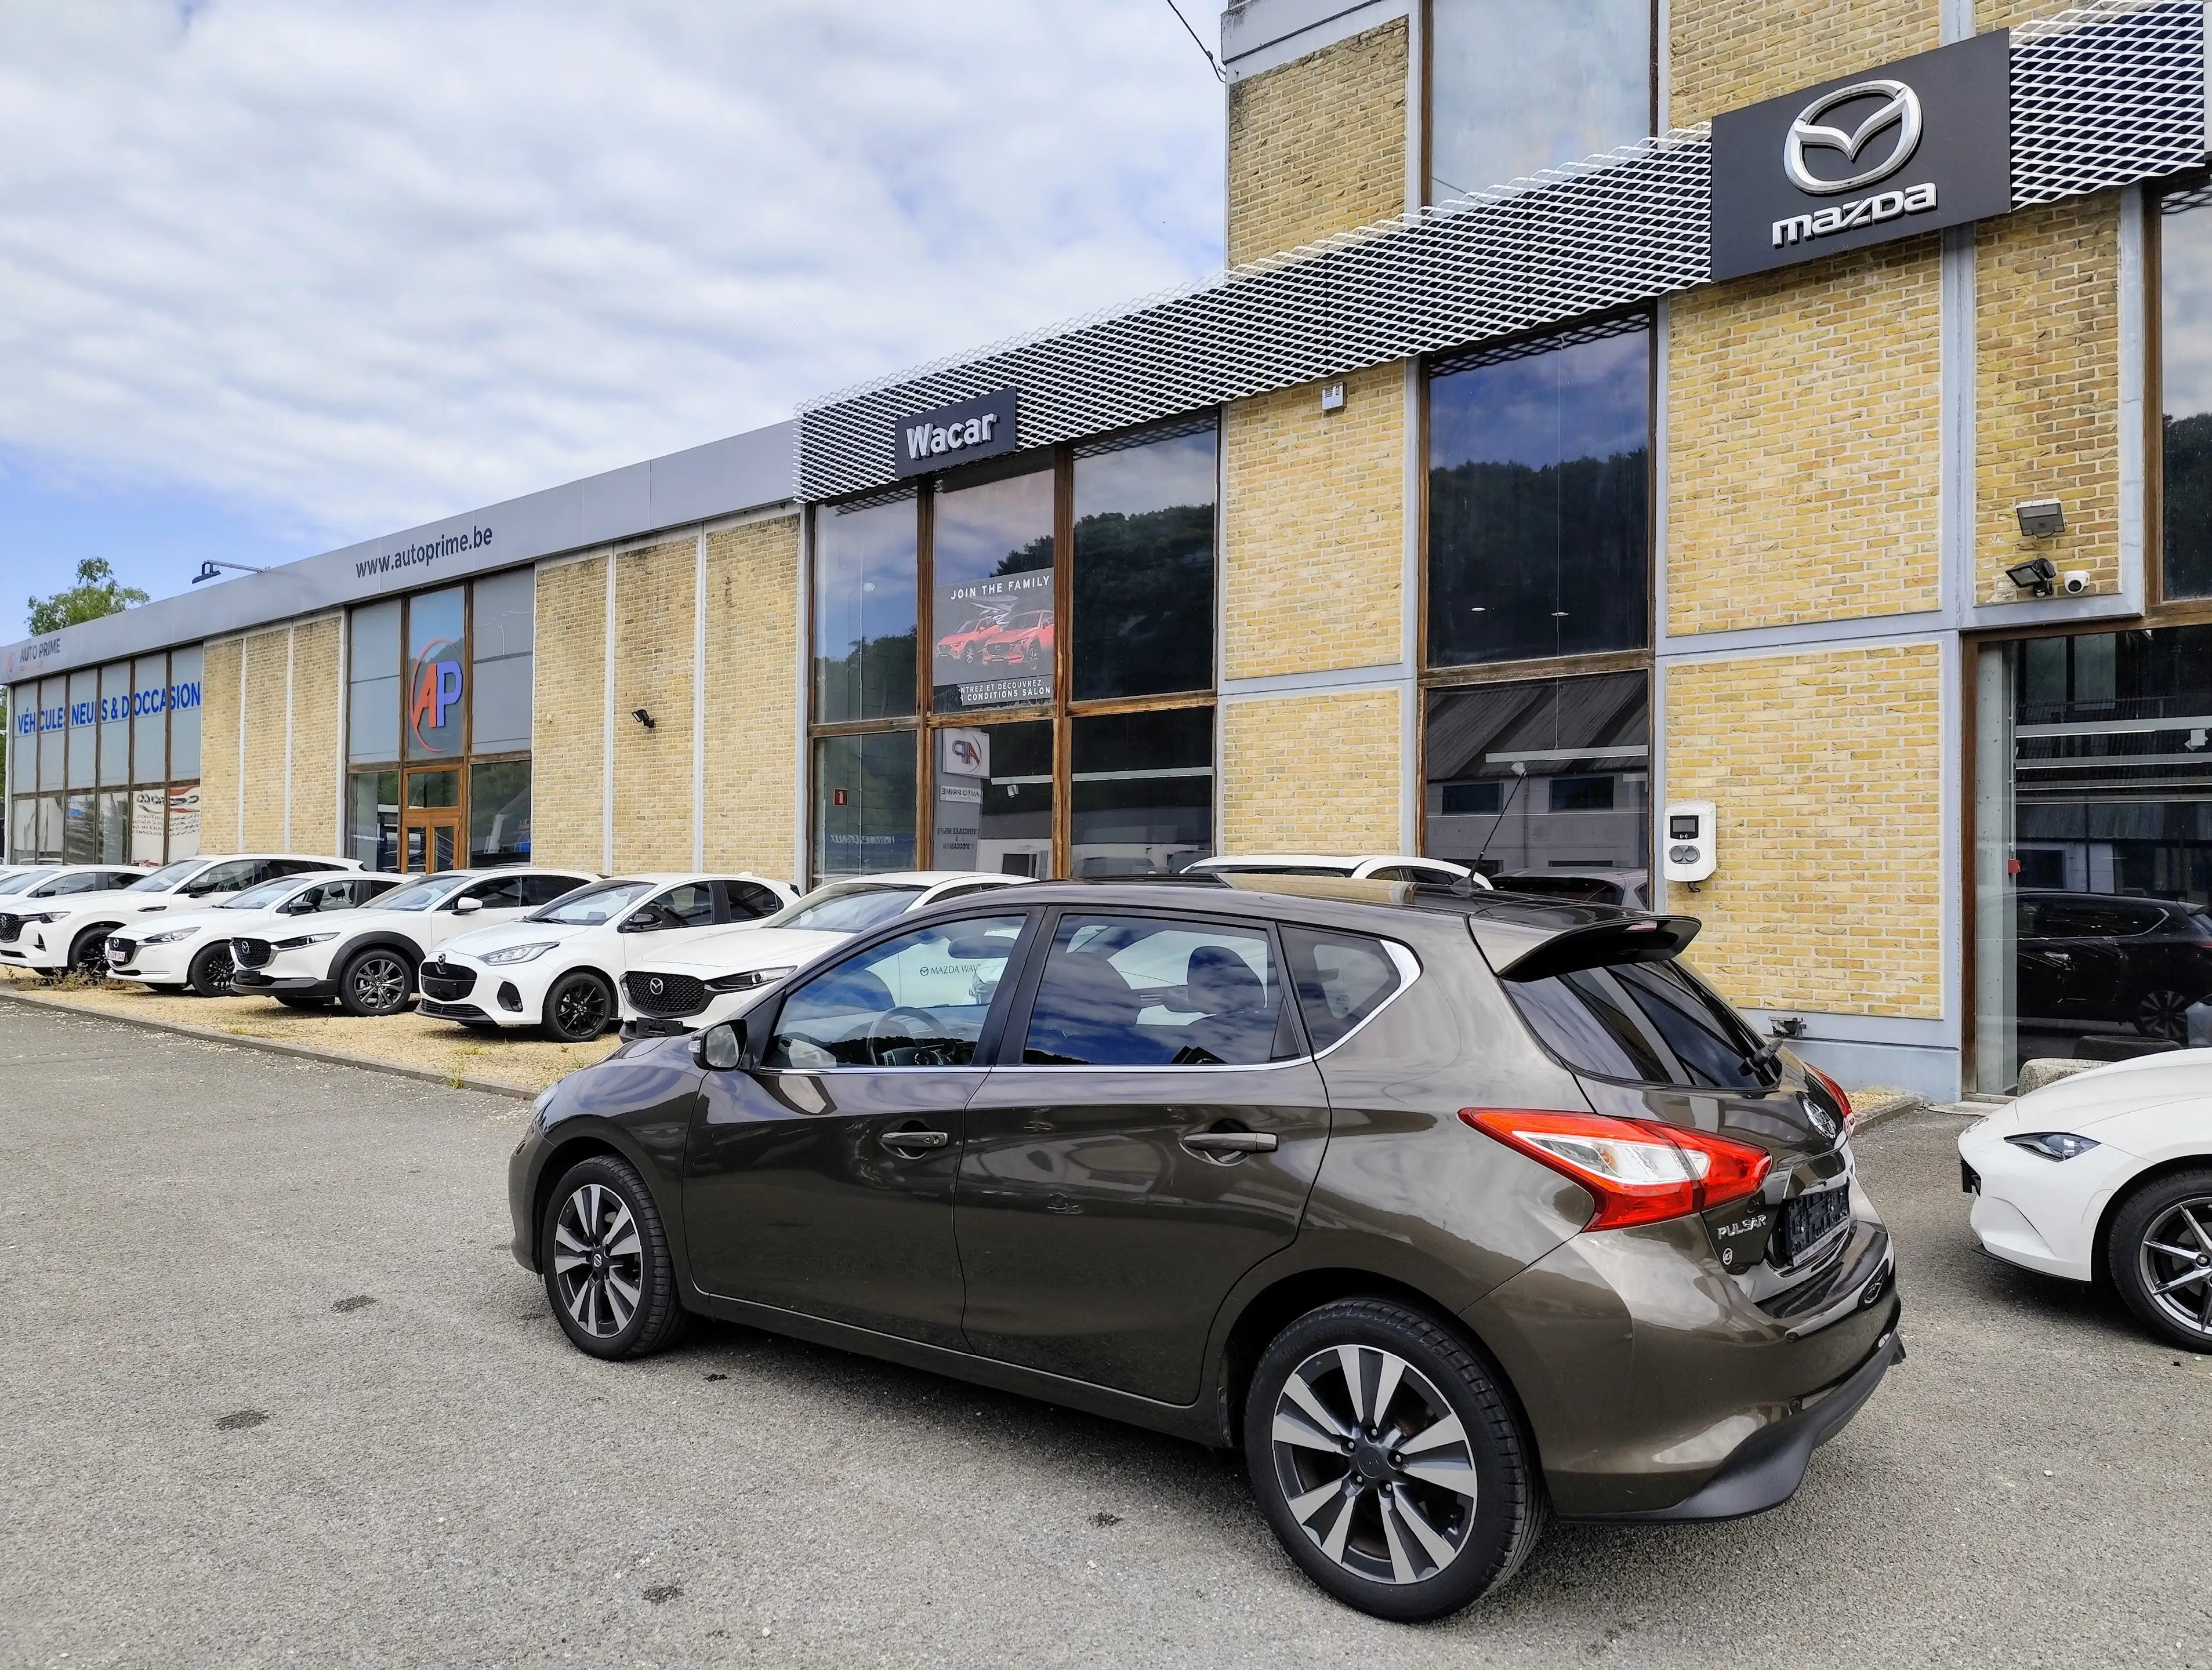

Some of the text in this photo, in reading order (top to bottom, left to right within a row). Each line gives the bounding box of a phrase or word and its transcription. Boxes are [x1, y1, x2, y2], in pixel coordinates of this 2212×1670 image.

[906, 413, 998, 459] Wacar
[356, 525, 492, 578] www.autoprime.be
[951, 575, 1050, 600] JOIN THE FAMILY
[20, 638, 60, 663] AUTO PRIME
[413, 660, 462, 728] AP
[959, 685, 984, 694] NTREZ
[998, 679, 1042, 690] DÉCOUVREZ
[967, 689, 1018, 701] CONDITIONS
[1022, 687, 1050, 696] SALON
[18, 707, 67, 735] VÉHCULE
[111, 697, 118, 720] &
[122, 681, 200, 718] DOCCASION
[931, 964, 982, 975] MAZDA WAV
[1717, 1214, 1767, 1240] PULSAR
